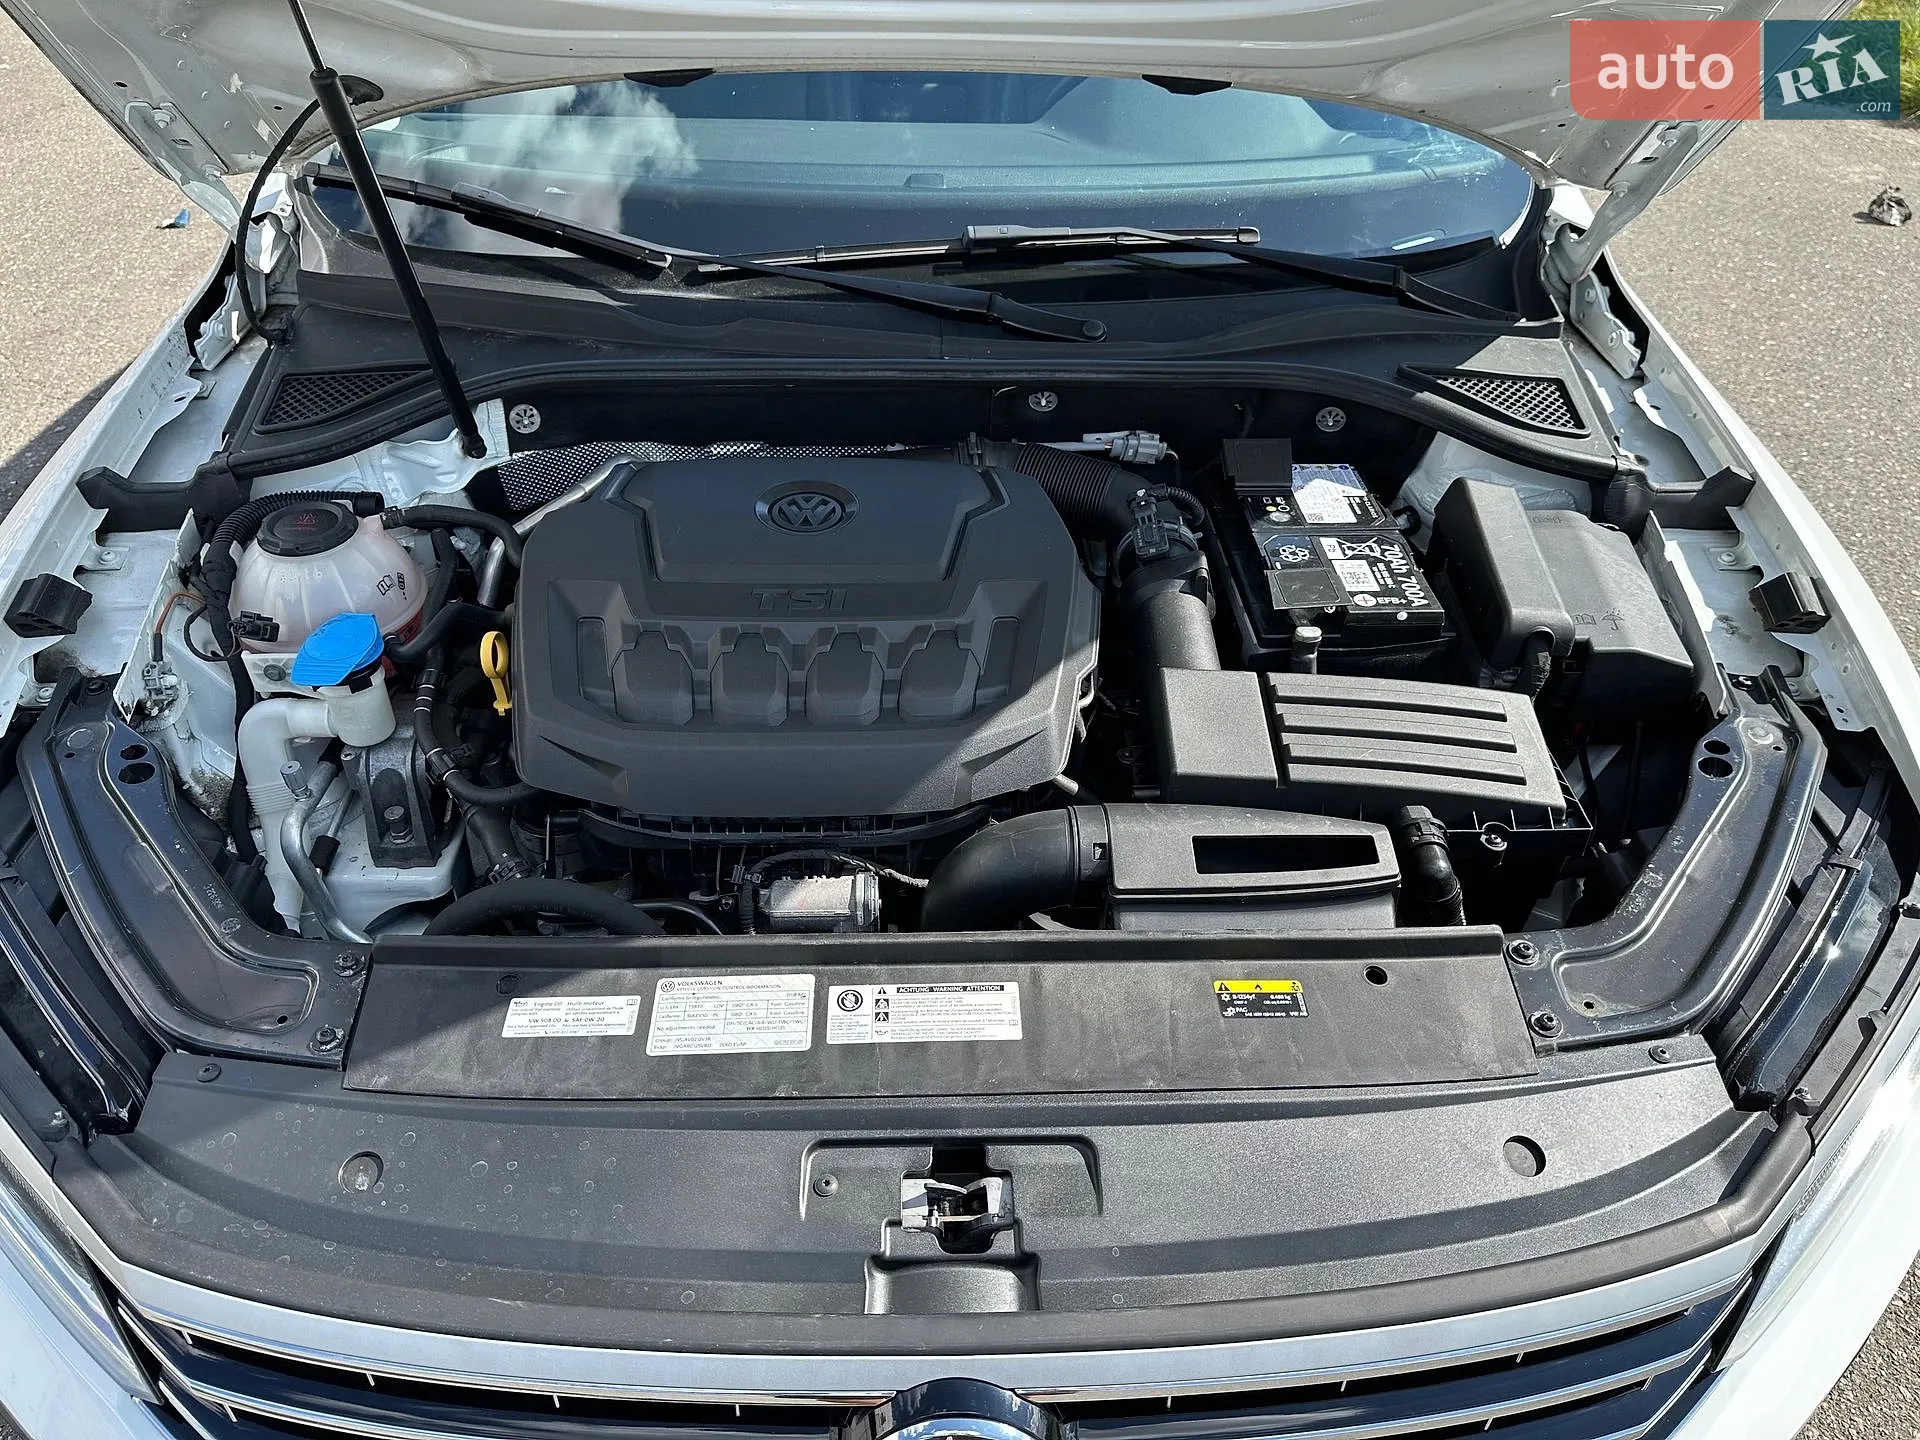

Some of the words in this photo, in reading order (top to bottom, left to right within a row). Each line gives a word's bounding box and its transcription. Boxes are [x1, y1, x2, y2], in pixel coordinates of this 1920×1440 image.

[1381, 543, 1410, 574] 70Ah
[1397, 575, 1429, 607] 700A
[751, 588, 848, 612] TSI
[1376, 596, 1408, 605] EFB+
[898, 986, 930, 994] ACHTUNG
[933, 985, 963, 993] WARNING
